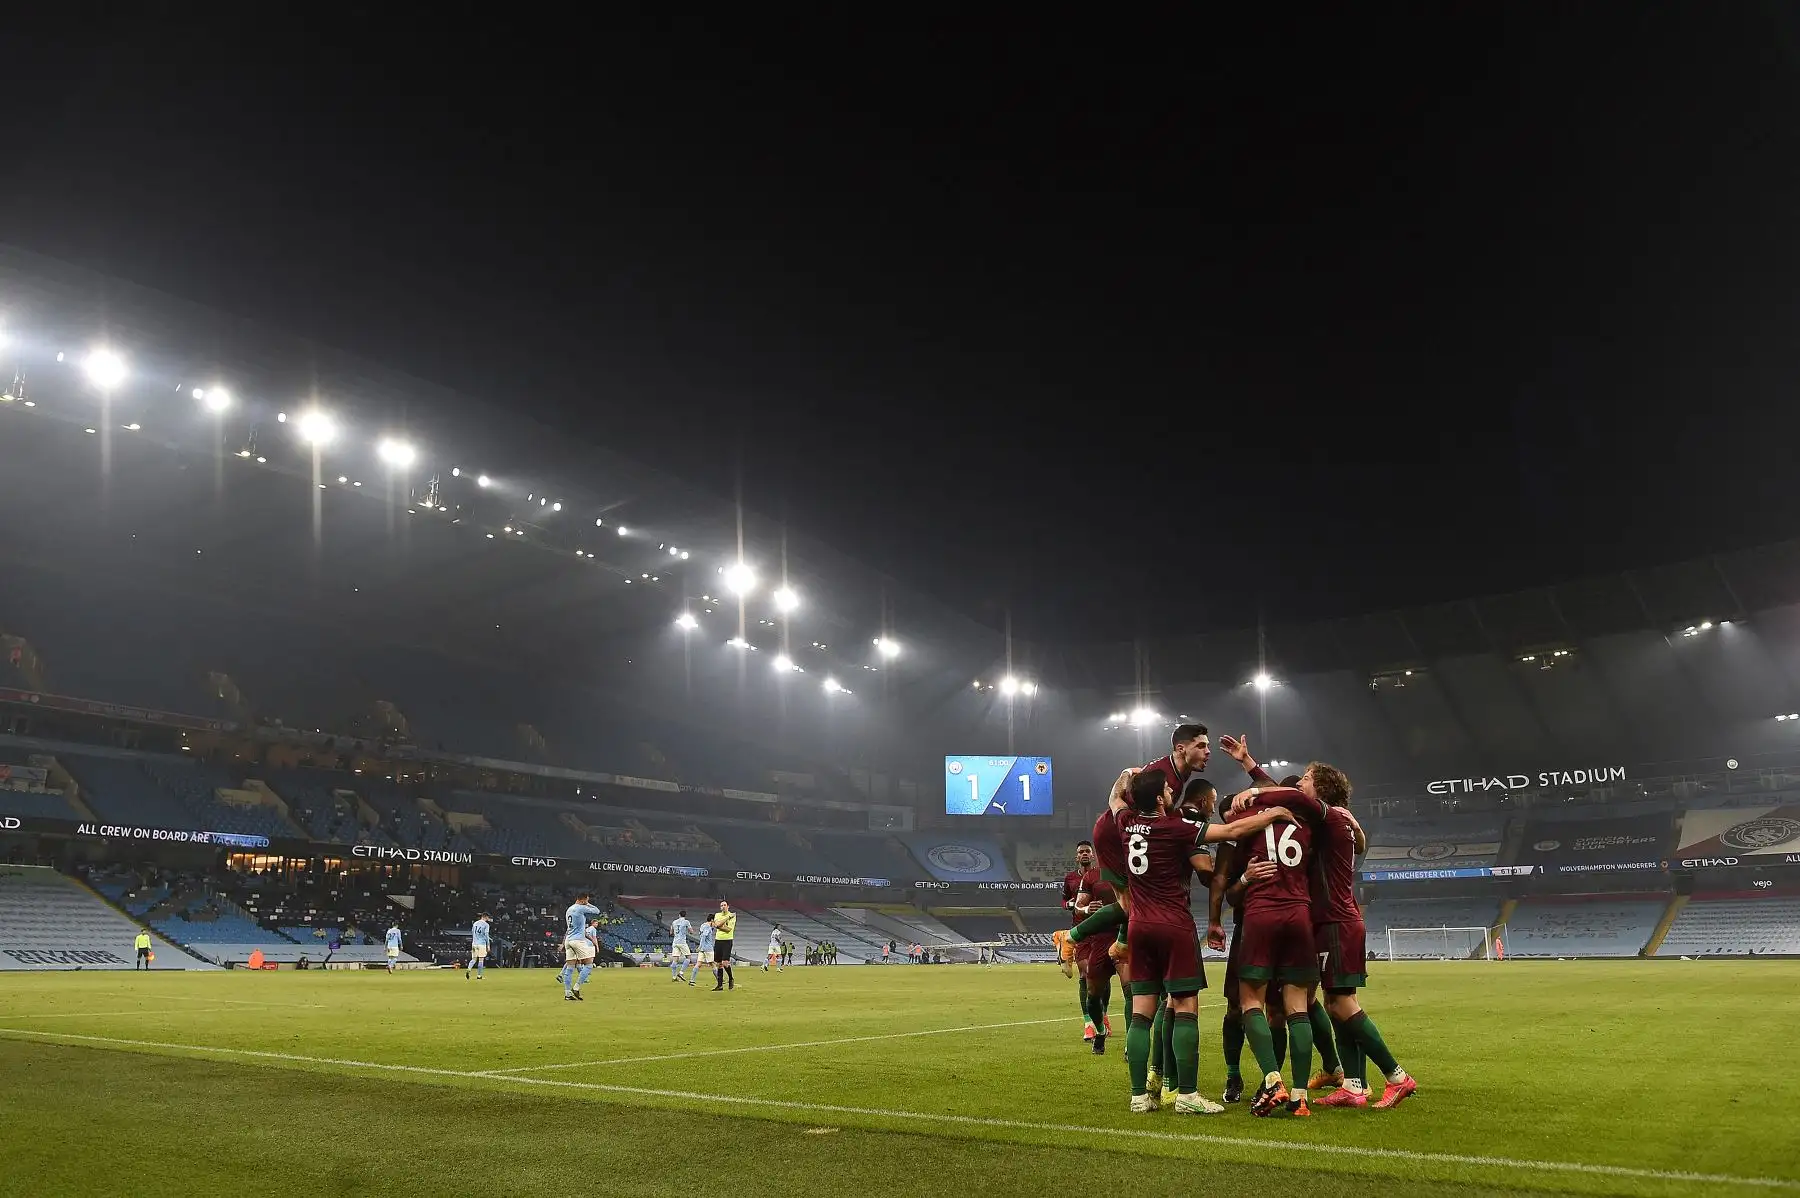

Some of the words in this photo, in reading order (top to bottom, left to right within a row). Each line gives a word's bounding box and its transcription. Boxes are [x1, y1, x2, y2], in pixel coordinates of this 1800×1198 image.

[1426, 775, 1530, 795] ETIHAD
[1538, 766, 1626, 787] STADIUM
[967, 774, 979, 801] 1
[1019, 774, 1031, 801] 1
[77, 823, 97, 835] ALL
[100, 825, 131, 838] CREW
[133, 828, 151, 839] ON
[152, 829, 188, 842] BOARD
[189, 832, 209, 844] ARE
[1265, 823, 1303, 867] 16
[352, 845, 421, 860] ETIHAD
[423, 849, 472, 864] STADIUM
[1128, 833, 1149, 875] 8
[511, 856, 557, 868] ETIHAD
[1559, 863, 1616, 872] WOLVERHAMPTON
[1616, 861, 1657, 870] WANDERERS
[1681, 857, 1739, 868] ETIHAD
[589, 862, 602, 870] ALL
[602, 862, 622, 872] CREW
[623, 864, 634, 872] ON
[635, 865, 657, 874] BOARD
[658, 866, 671, 875] ARE
[1479, 867, 1485, 877] 1
[1538, 865, 1545, 874] 1
[736, 871, 771, 881] ETIHAD
[806, 875, 822, 884] CREW
[822, 876, 831, 884] ON
[831, 877, 850, 885] BOARD
[1387, 871, 1439, 880] MANCHESTER
[1439, 869, 1458, 879] CITY
[914, 881, 950, 890] ETIHAD
[1045, 882, 1058, 890] ARE
[1752, 880, 1773, 889] vejo
